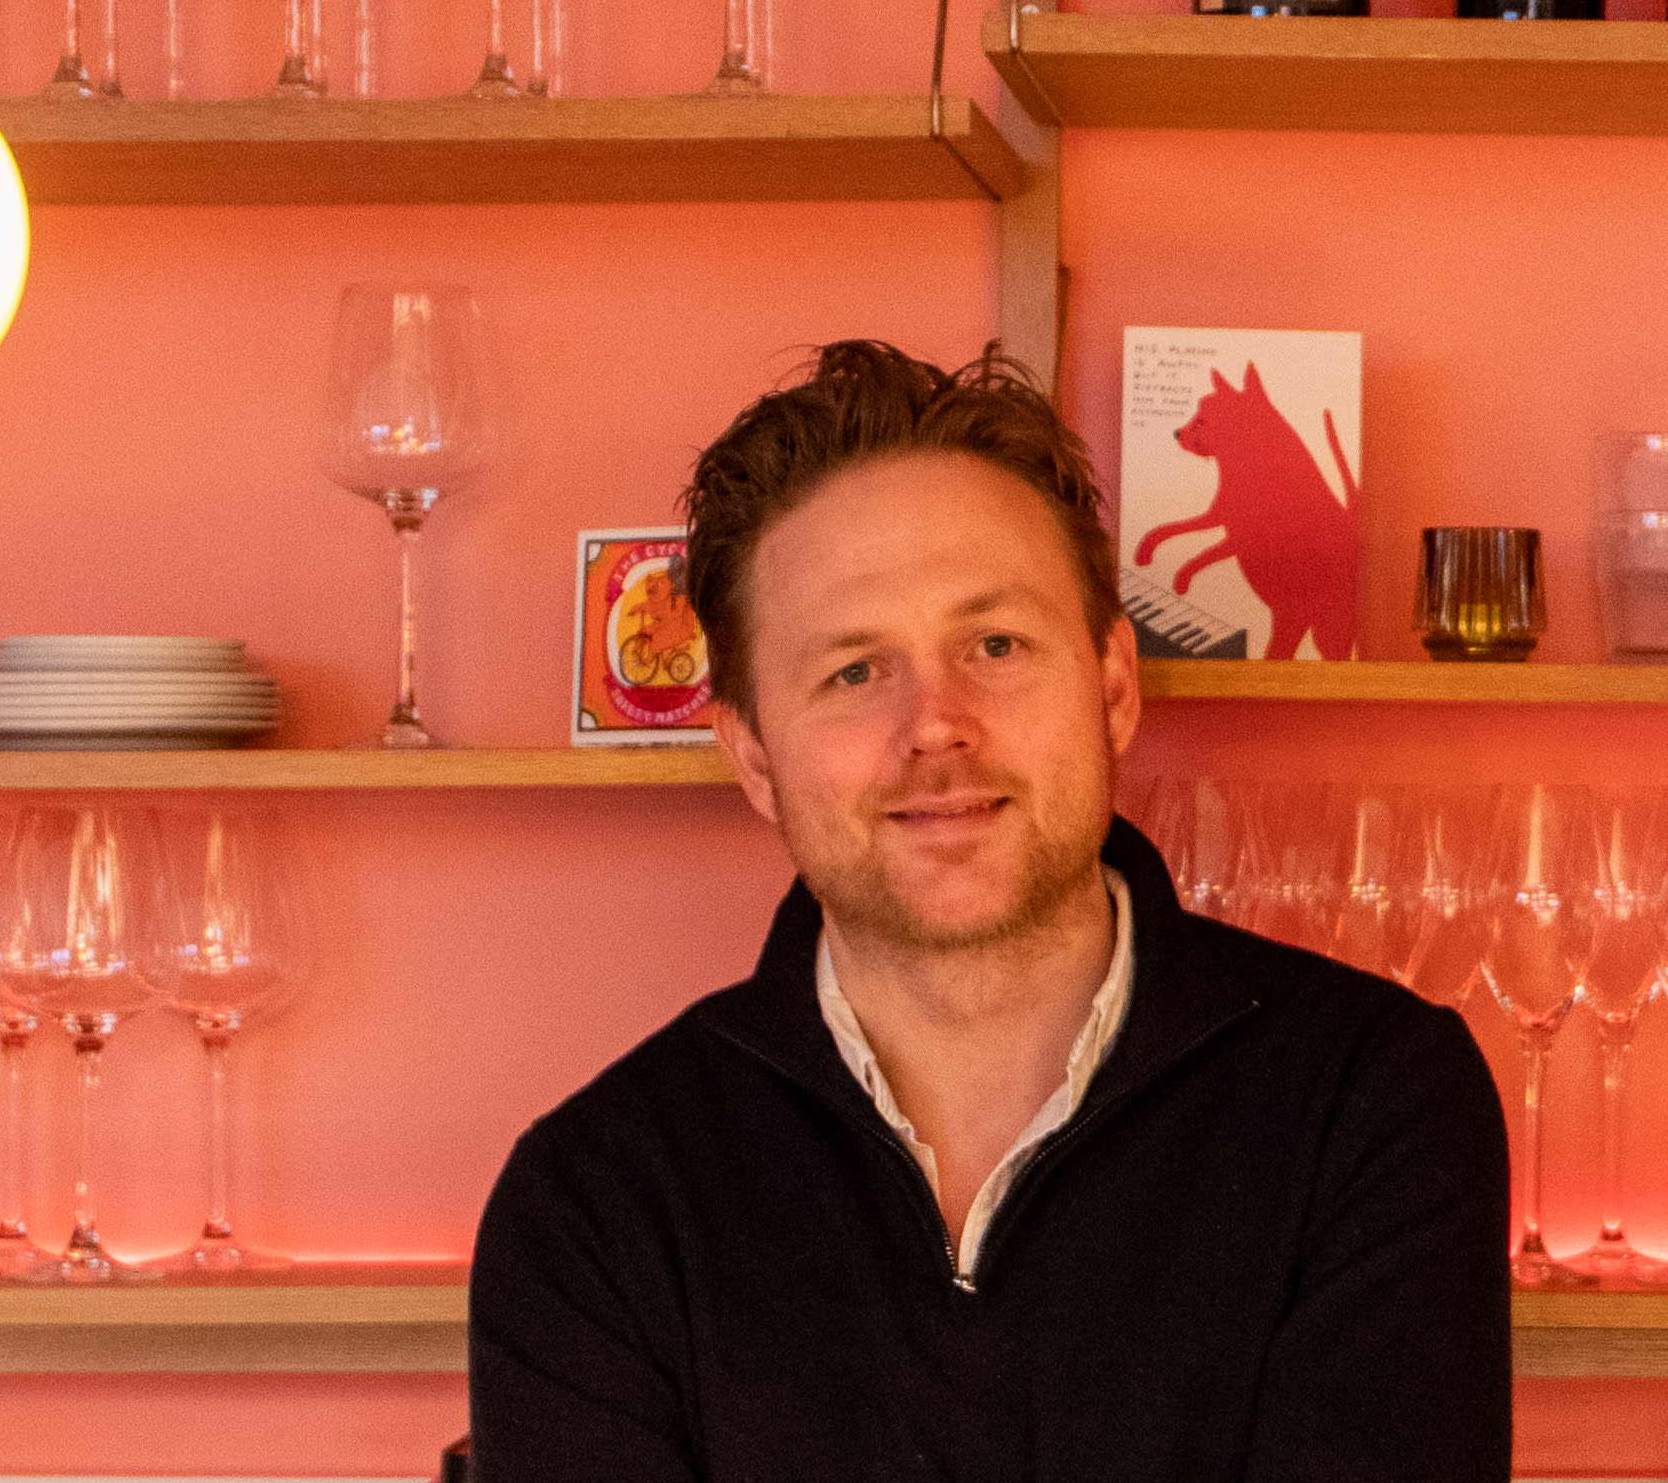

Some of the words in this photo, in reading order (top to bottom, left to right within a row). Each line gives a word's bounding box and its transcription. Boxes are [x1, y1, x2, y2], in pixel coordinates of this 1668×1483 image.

[613, 550, 639, 582] THE
[610, 687, 653, 723] SAFETY
[654, 684, 712, 724] MATCHES
